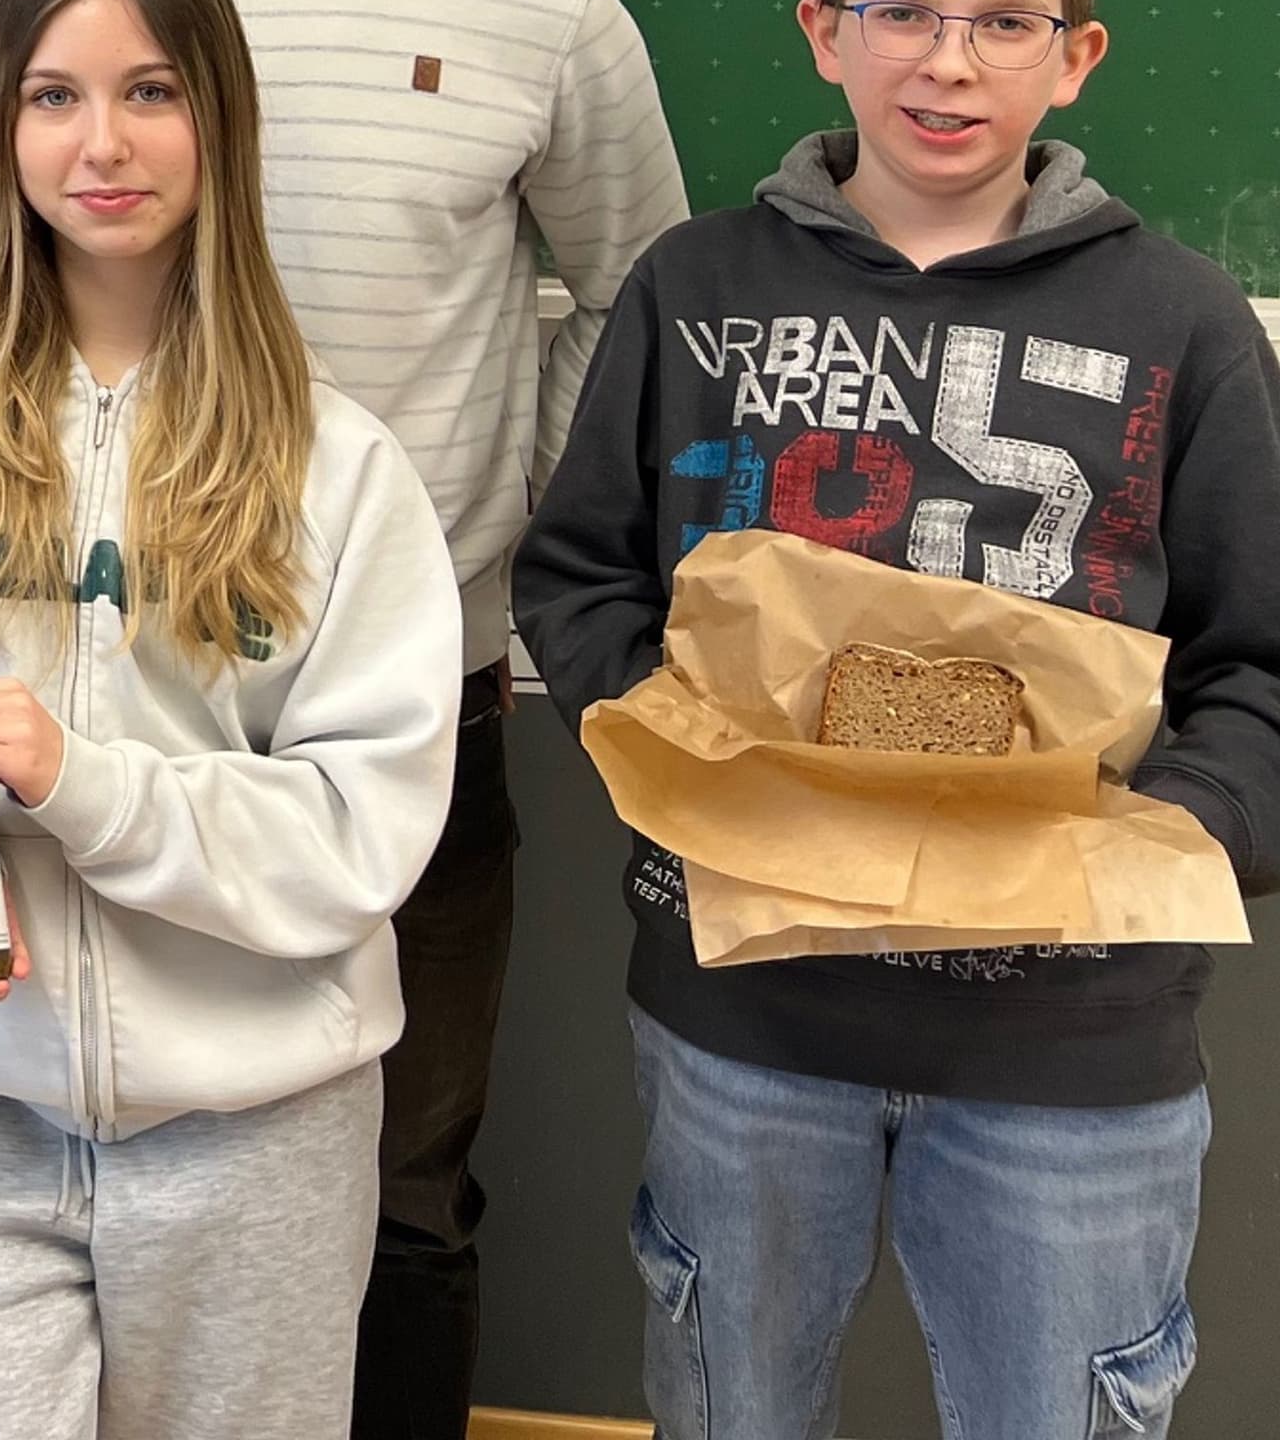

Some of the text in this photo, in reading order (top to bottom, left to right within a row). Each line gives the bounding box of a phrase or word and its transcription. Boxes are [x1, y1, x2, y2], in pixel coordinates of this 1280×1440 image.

[733, 371, 920, 435] AREA
[1121, 366, 1174, 463] FREE
[1055, 469, 1081, 499] NO
[634, 877, 672, 905] TEST
